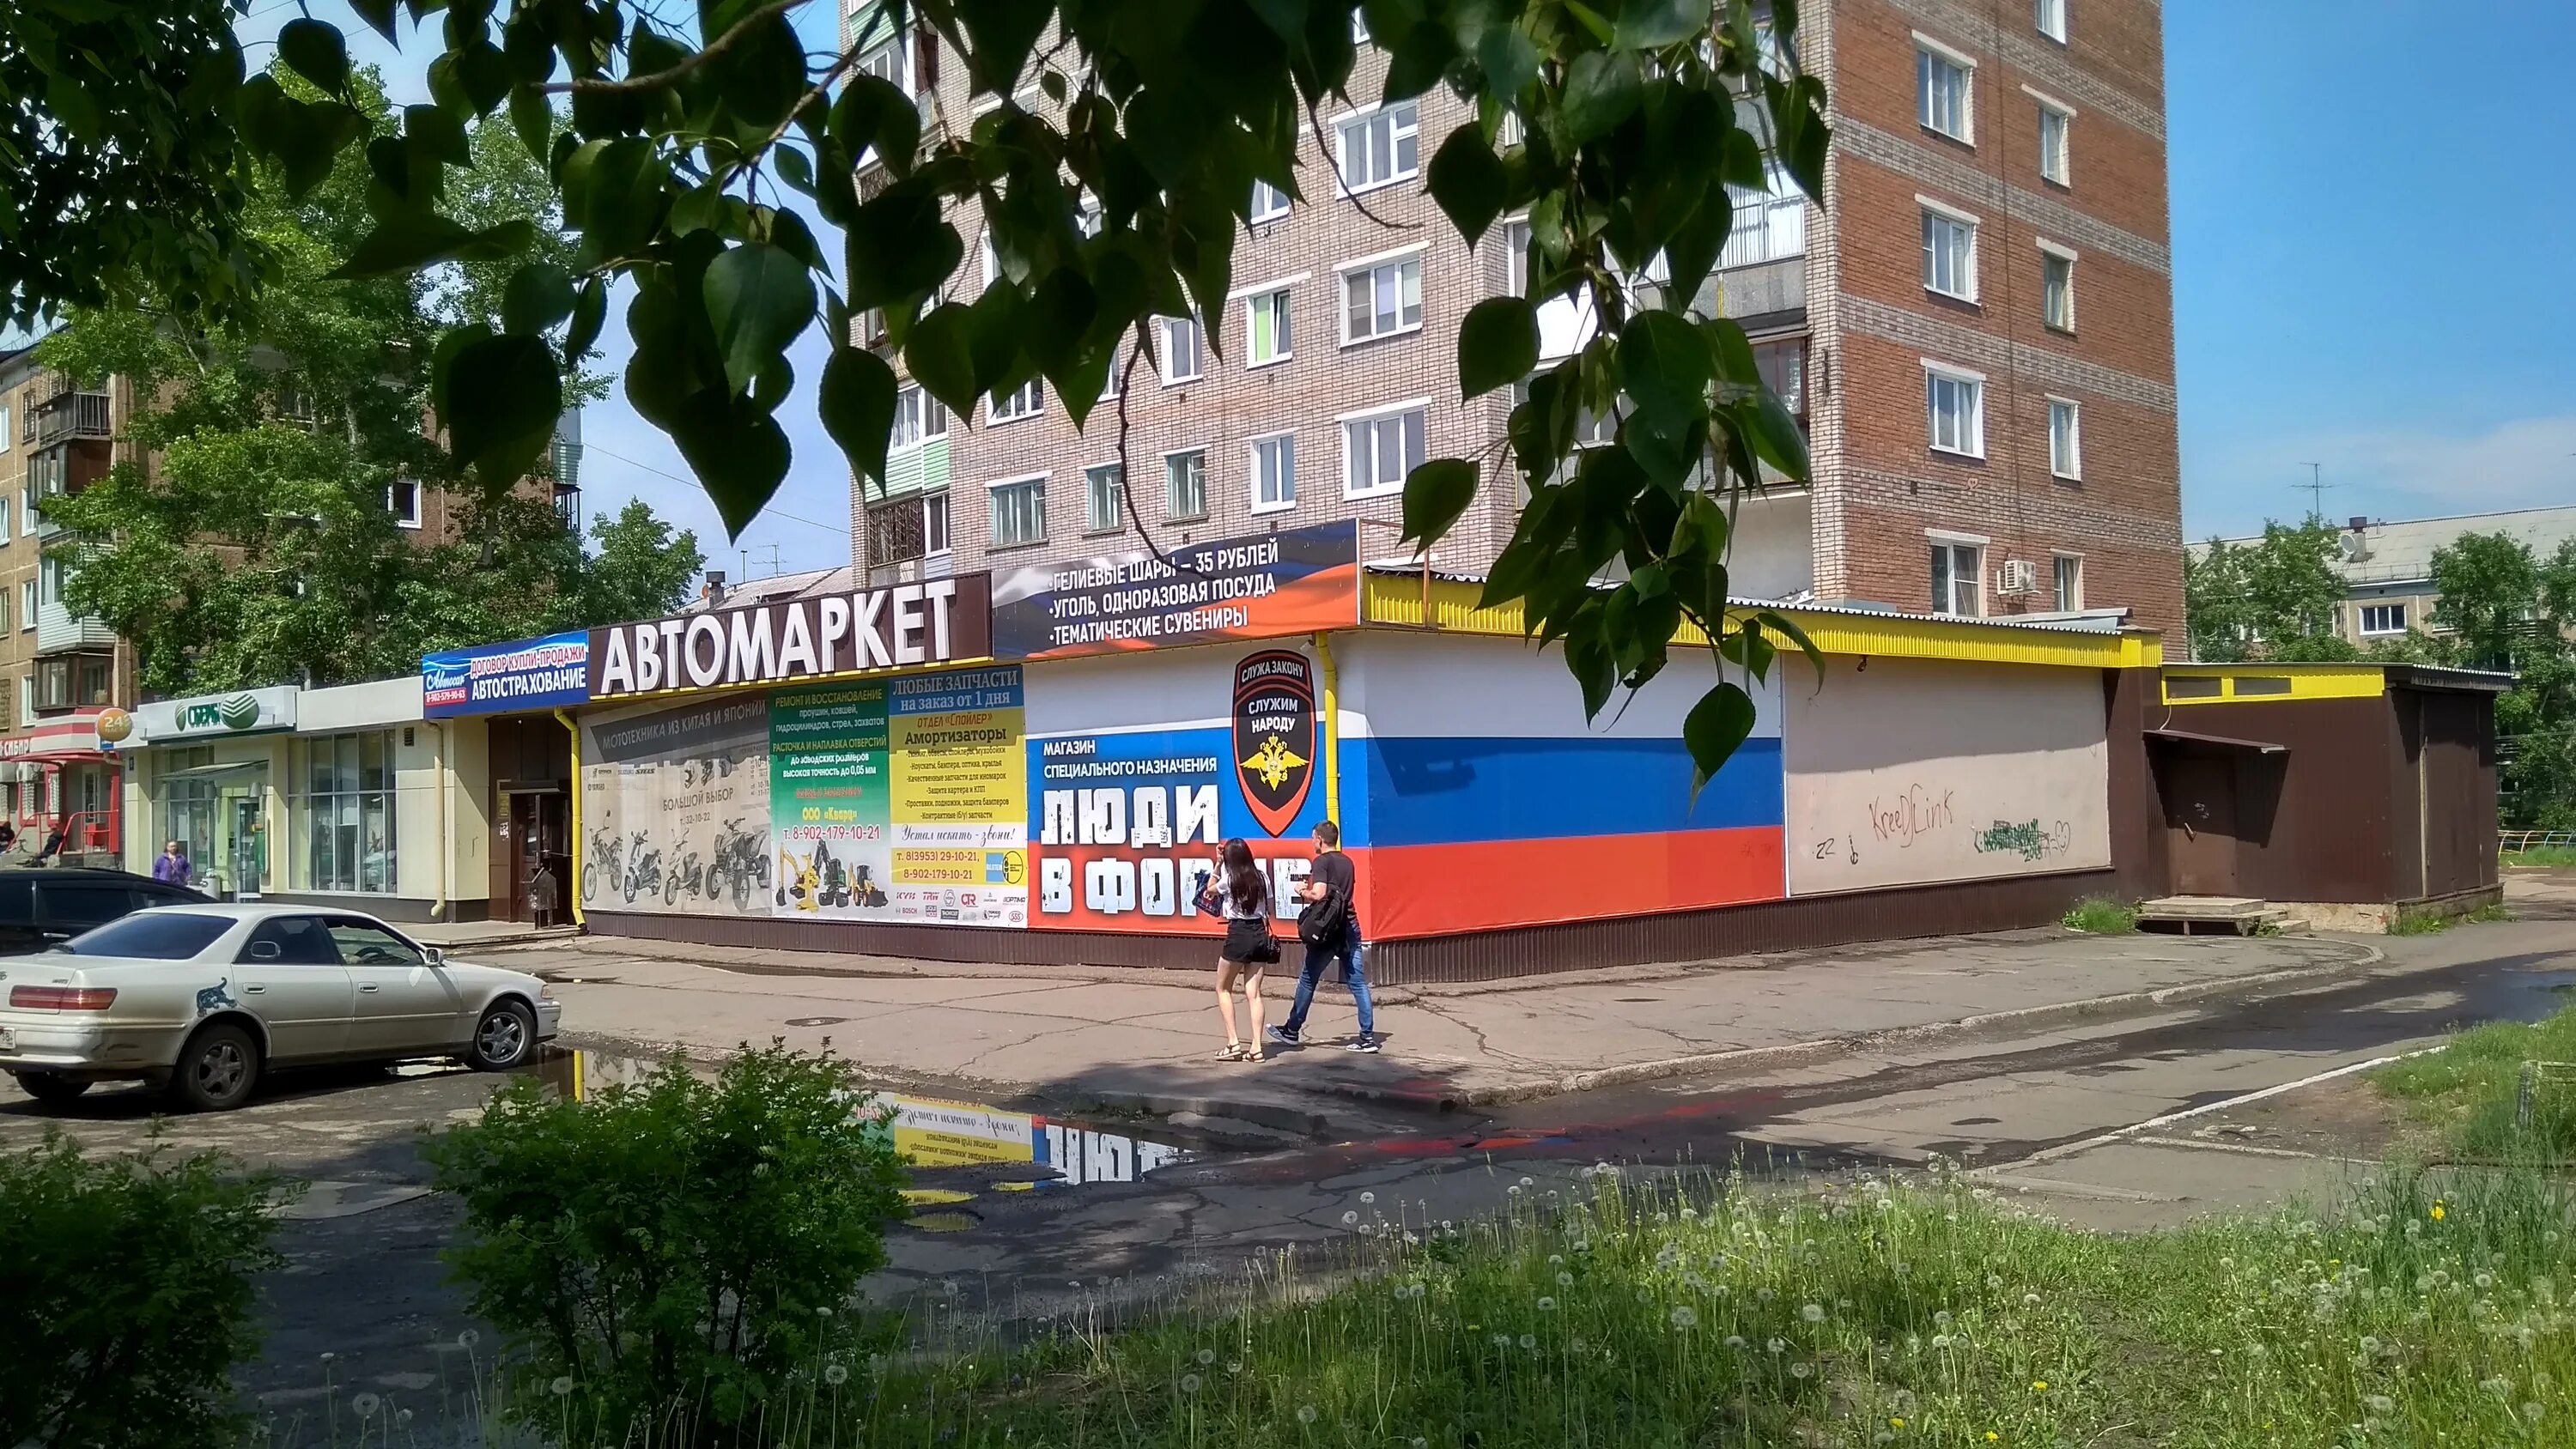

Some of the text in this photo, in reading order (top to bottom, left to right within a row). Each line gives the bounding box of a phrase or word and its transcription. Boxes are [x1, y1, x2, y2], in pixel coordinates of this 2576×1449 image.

[1054, 564, 1126, 592] ГЕЛИЕВЫЕ
[1129, 557, 1176, 583] ШАРЫ
[1195, 552, 1213, 573] 35
[1218, 537, 1279, 570] РУБЛЕЙ
[1054, 573, 1276, 619] УГОЛЬ, ОДНОРАЗОВАЯ ПОСУДА
[1054, 605, 1248, 646] ТЕМАТИЧЕСКИЕ СУВЕНИРЫ
[601, 579, 955, 694] АВТОМАРКЕТ
[471, 645, 586, 678] ДОГОВОР КУПЛИ-ПРОДАЖИ
[1242, 660, 1303, 682] СЛУЖА ЗАКОНУ
[472, 668, 586, 700] АВТОСТРАХОВАНИЕ
[893, 670, 1018, 695] ЛЮБЫЕ ЗАПЧАСТИ
[775, 688, 883, 707] РЕМОНТ И ВОССТАНОВЛЕНИЕ
[901, 691, 1011, 711] на заказ от 1 дня
[1249, 698, 1297, 714] СЛУЖИМ
[799, 704, 858, 719] проушин, ковшей,
[104, 716, 124, 728] 24
[775, 718, 884, 734] гидроцилиндров, стрел, захватов
[917, 715, 944, 728] ОТДЕЛ
[1252, 716, 1296, 733] НАРОДУ
[603, 724, 665, 750] МОТОТЕХНИКА
[668, 721, 680, 735] ИЗ
[682, 714, 711, 732] КИТАЯ
[714, 712, 721, 724] И
[905, 728, 1007, 746] Амортизаторы
[773, 741, 805, 752] РАСТОЧКА
[806, 741, 811, 749] И
[812, 739, 848, 749] НАПЛАВКА
[848, 735, 887, 748] ОТВЕРСТИЙ
[1043, 740, 1096, 756] МАГАЗИН
[791, 753, 869, 767] до заводских размеров
[981, 760, 1002, 768] крылья
[1043, 757, 1218, 779] СПЕЦИАЛЬНОГО НАЗНАЧЕНИЯ
[783, 765, 877, 778] высокая точность до 0,05 мм
[979, 773, 1006, 781] иномарок
[663, 787, 733, 811] БОЛЬШОЙ ВЫБОР
[948, 786, 969, 795] картера
[982, 797, 1009, 807] бамперов
[686, 812, 710, 824] 32-10-22
[802, 807, 820, 821] ООО
[1041, 785, 1219, 848] ЛЮДИ
[793, 825, 880, 840] 8-902-179-10-21
[902, 824, 934, 841] Устал
[937, 830, 972, 840] искать
[981, 824, 1016, 846] звони!
[906, 851, 938, 862] 8(3953)
[940, 851, 980, 863] 29-10-21,
[903, 869, 973, 880] 8-902-179-10-21
[1041, 858, 1072, 913] В
[961, 894, 976, 906] CTR
